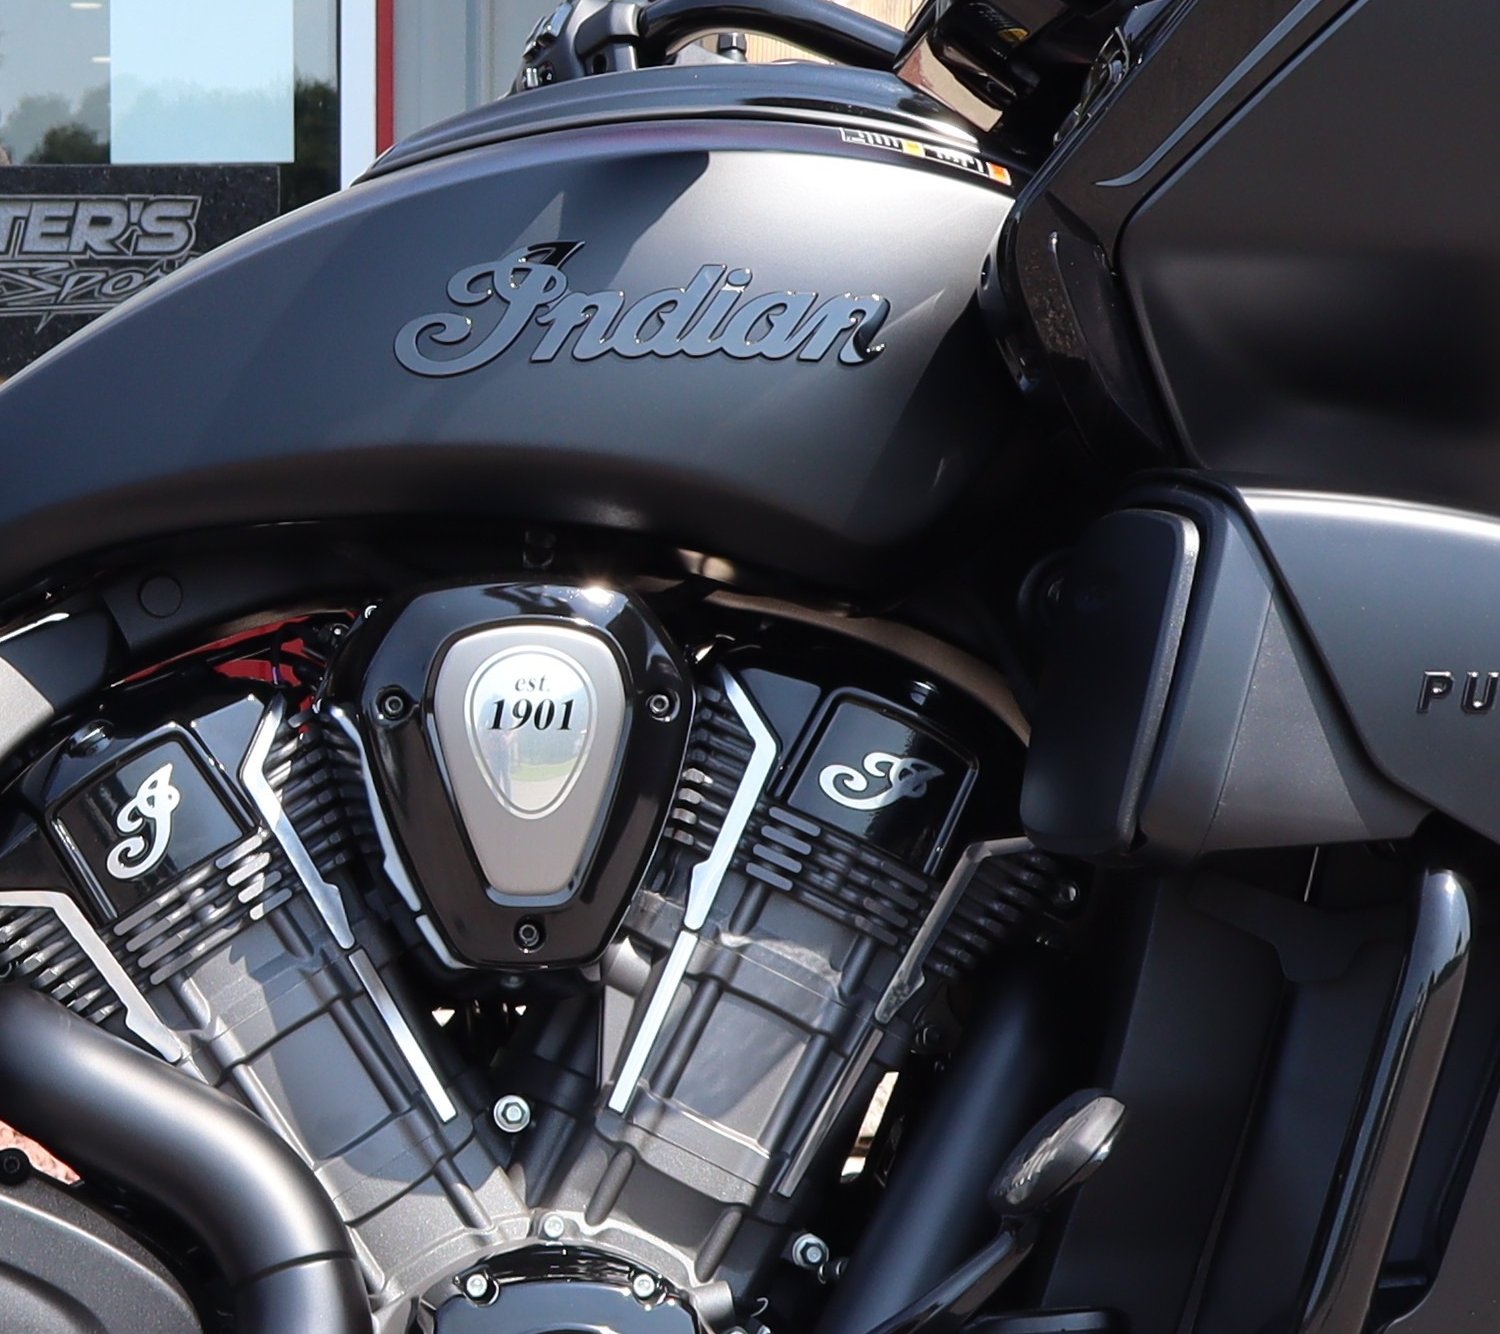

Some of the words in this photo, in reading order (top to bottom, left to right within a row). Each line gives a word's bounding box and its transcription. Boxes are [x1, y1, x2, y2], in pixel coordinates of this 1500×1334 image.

[394, 240, 891, 377] Indian
[514, 674, 550, 692] est.
[488, 698, 575, 731] 1901
